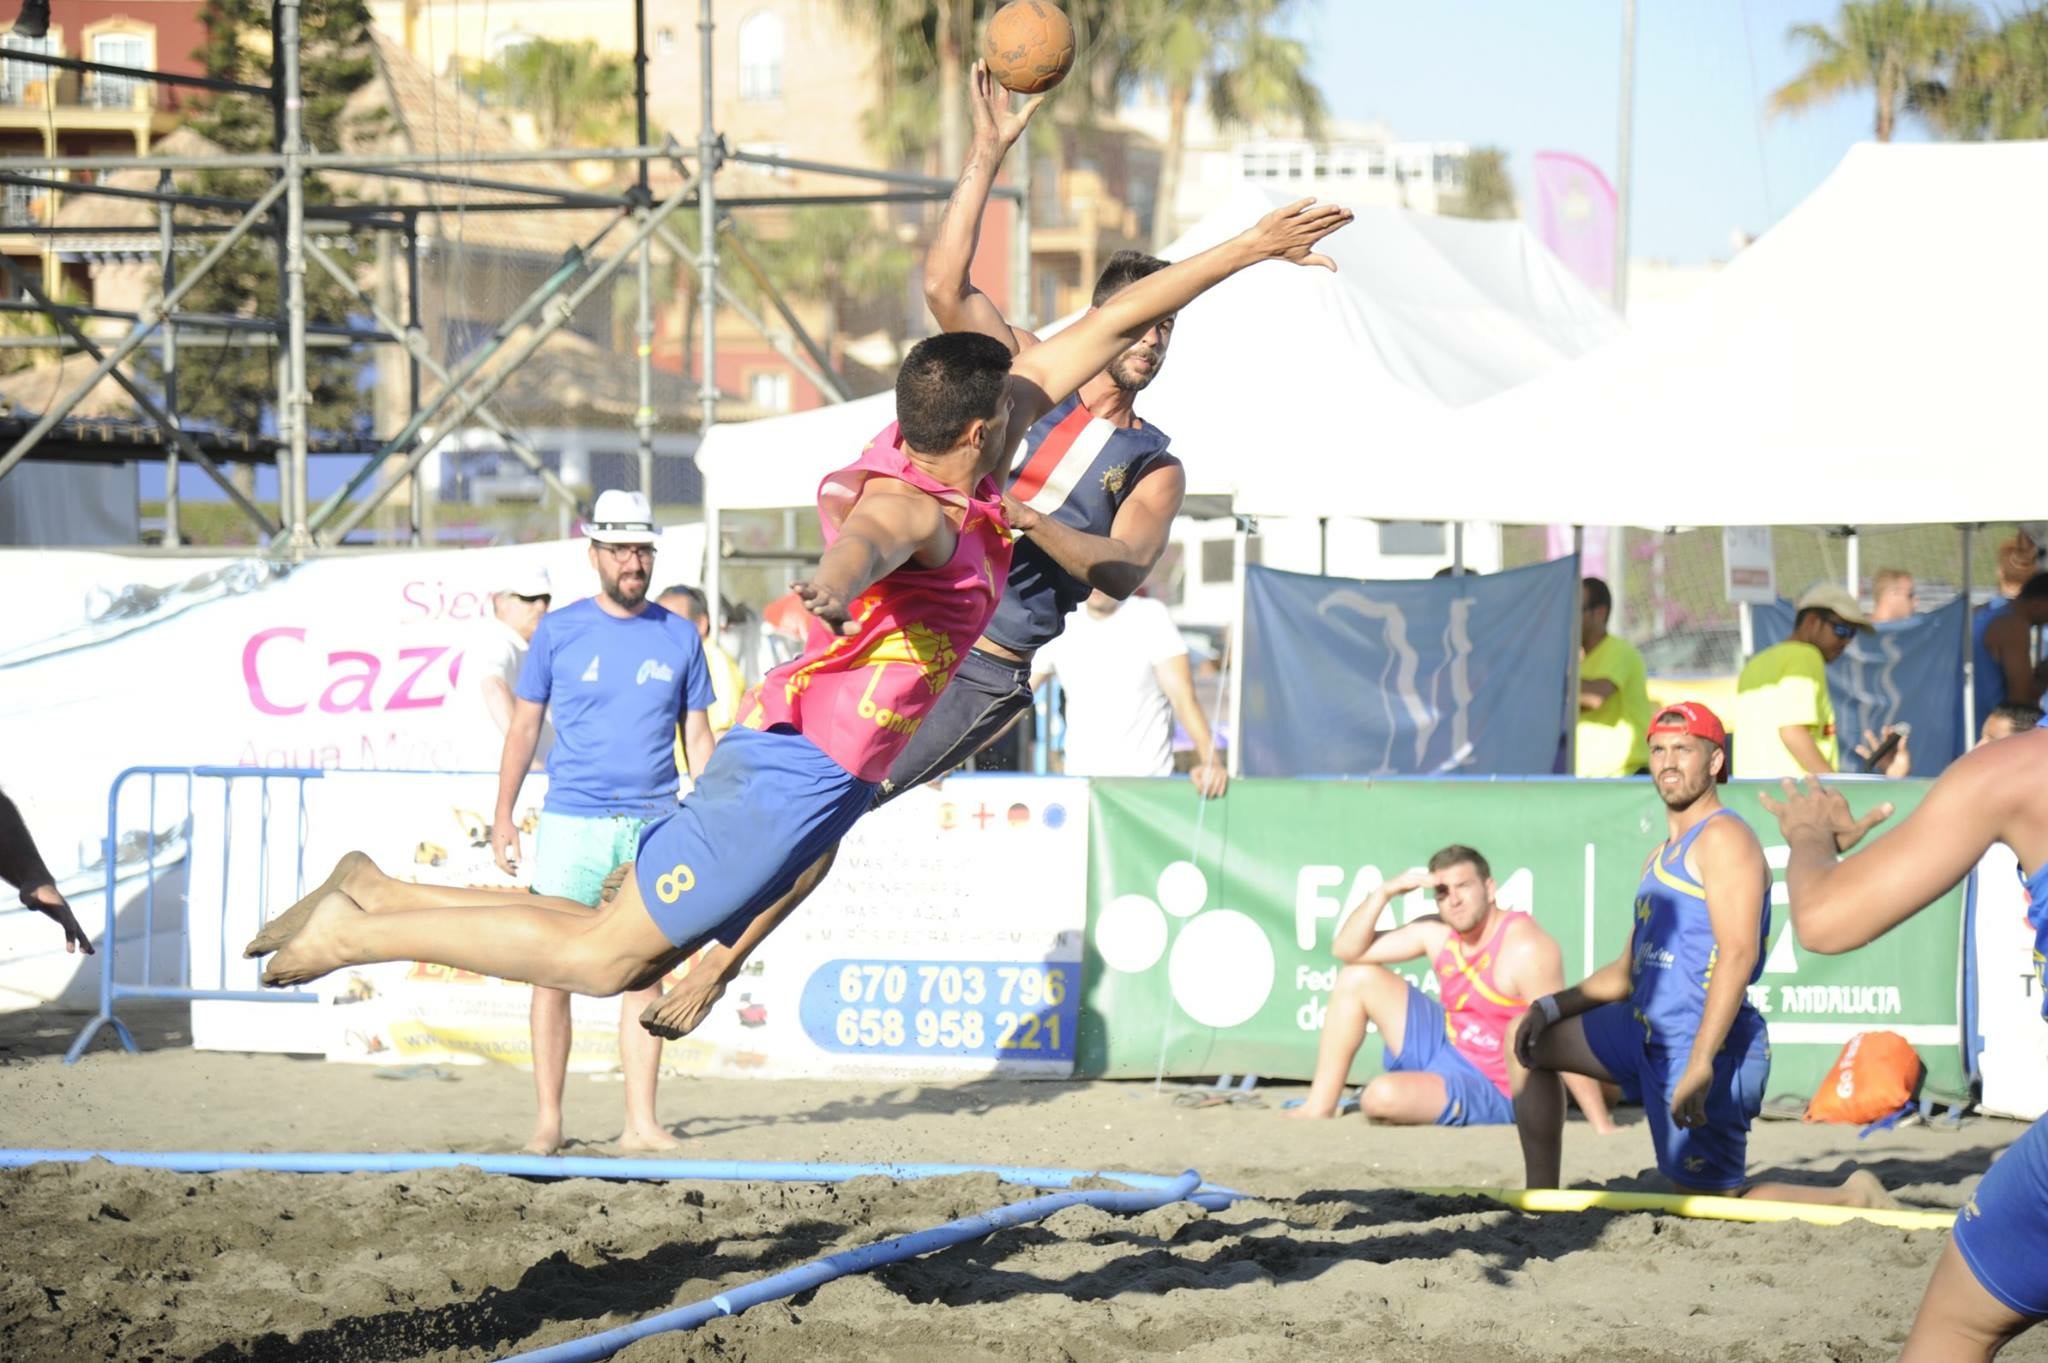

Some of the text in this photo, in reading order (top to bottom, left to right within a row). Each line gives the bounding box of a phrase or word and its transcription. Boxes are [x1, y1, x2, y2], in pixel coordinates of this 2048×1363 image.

[403, 580, 494, 621] Sier
[242, 626, 465, 717] Caz
[655, 864, 696, 904] 8
[839, 964, 1066, 1006] 670 703 796
[1780, 984, 1902, 1014] ANDALUCIA
[836, 1007, 1061, 1050] 658 958 221
